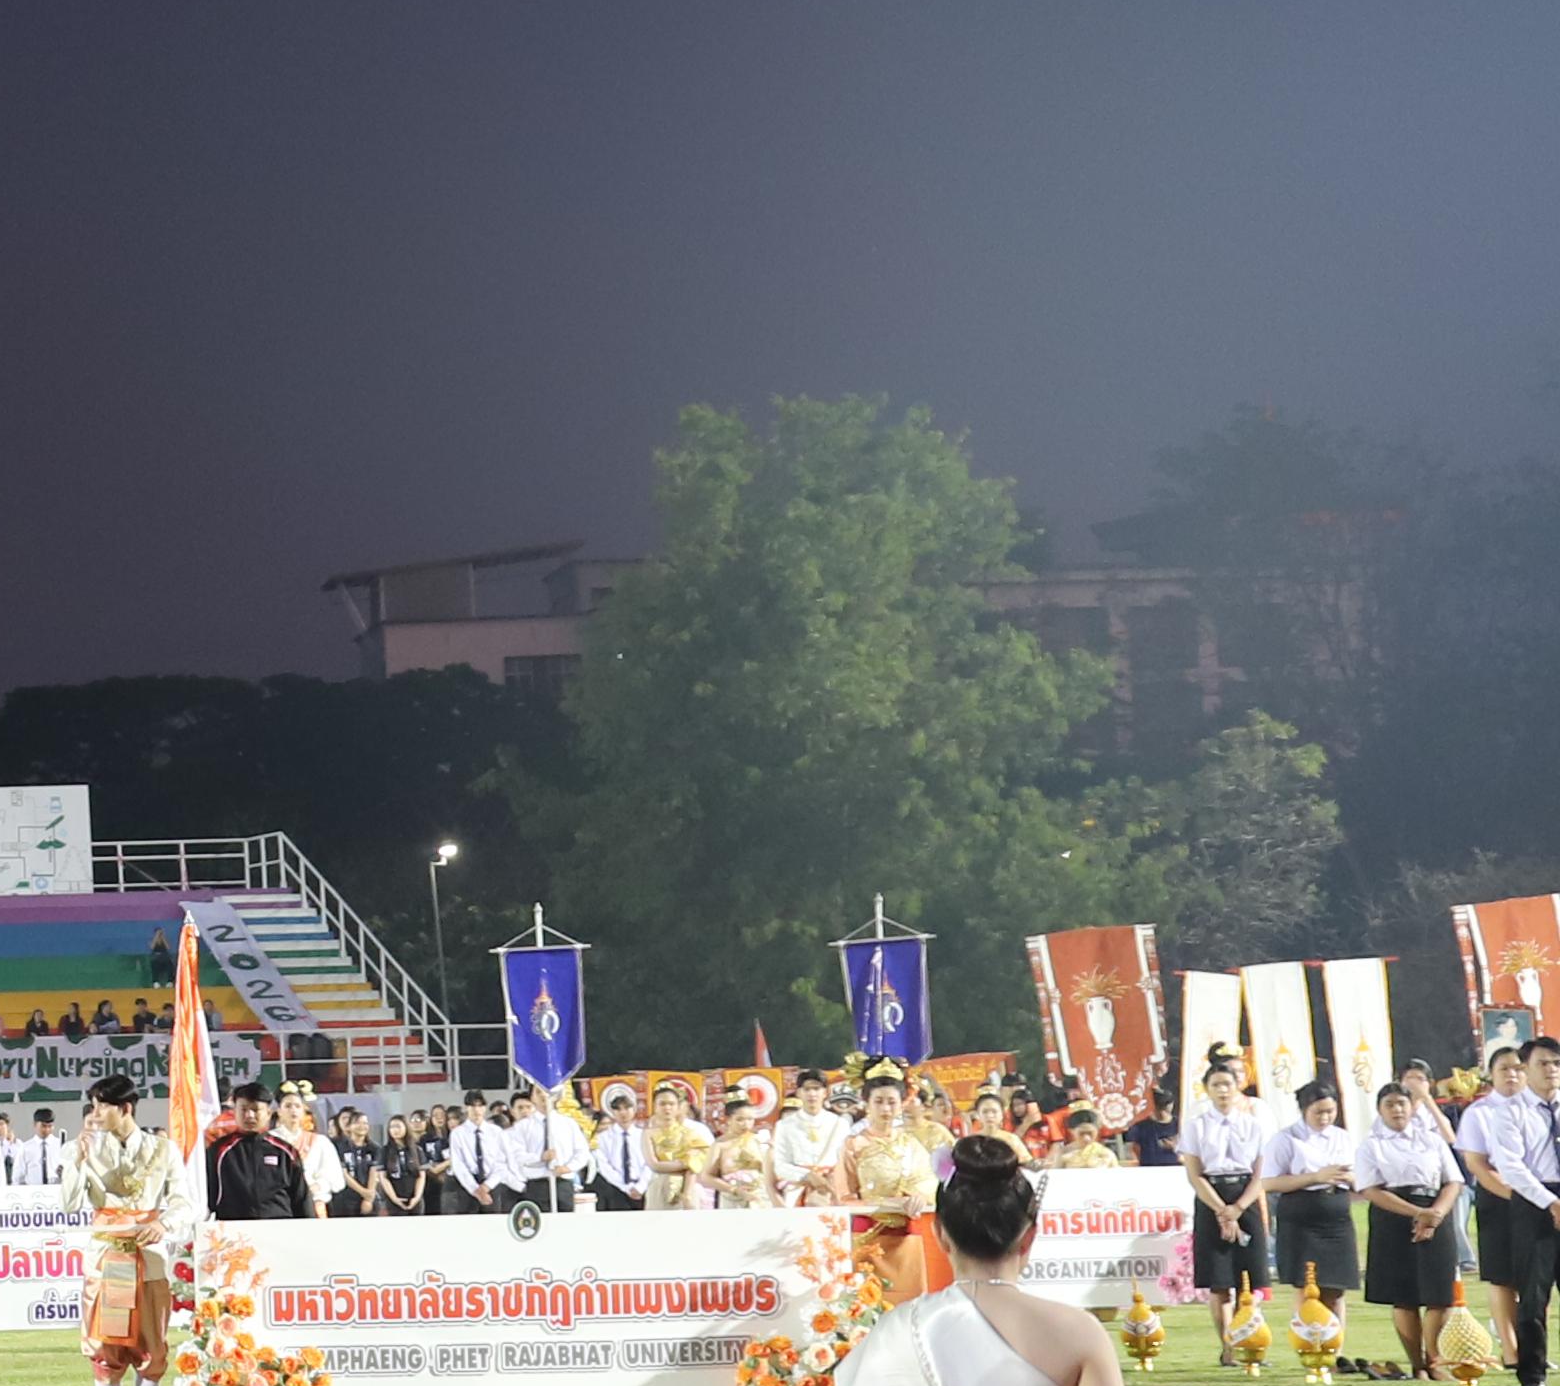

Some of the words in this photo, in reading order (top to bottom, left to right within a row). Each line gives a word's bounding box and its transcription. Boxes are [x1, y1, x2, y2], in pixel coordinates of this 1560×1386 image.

[1041, 1203, 1184, 1236] หารนักศึกษา
[1022, 1258, 1162, 1280] ORGANIZATION
[272, 1270, 777, 1327] มหาวิทยาลัยราชภัฏกำแพงเพชร
[323, 1346, 421, 1371] MPHAENG
[439, 1346, 489, 1370] PHET
[505, 1343, 612, 1367] RAJABHAT
[625, 1338, 749, 1365] UNIVERSITY
